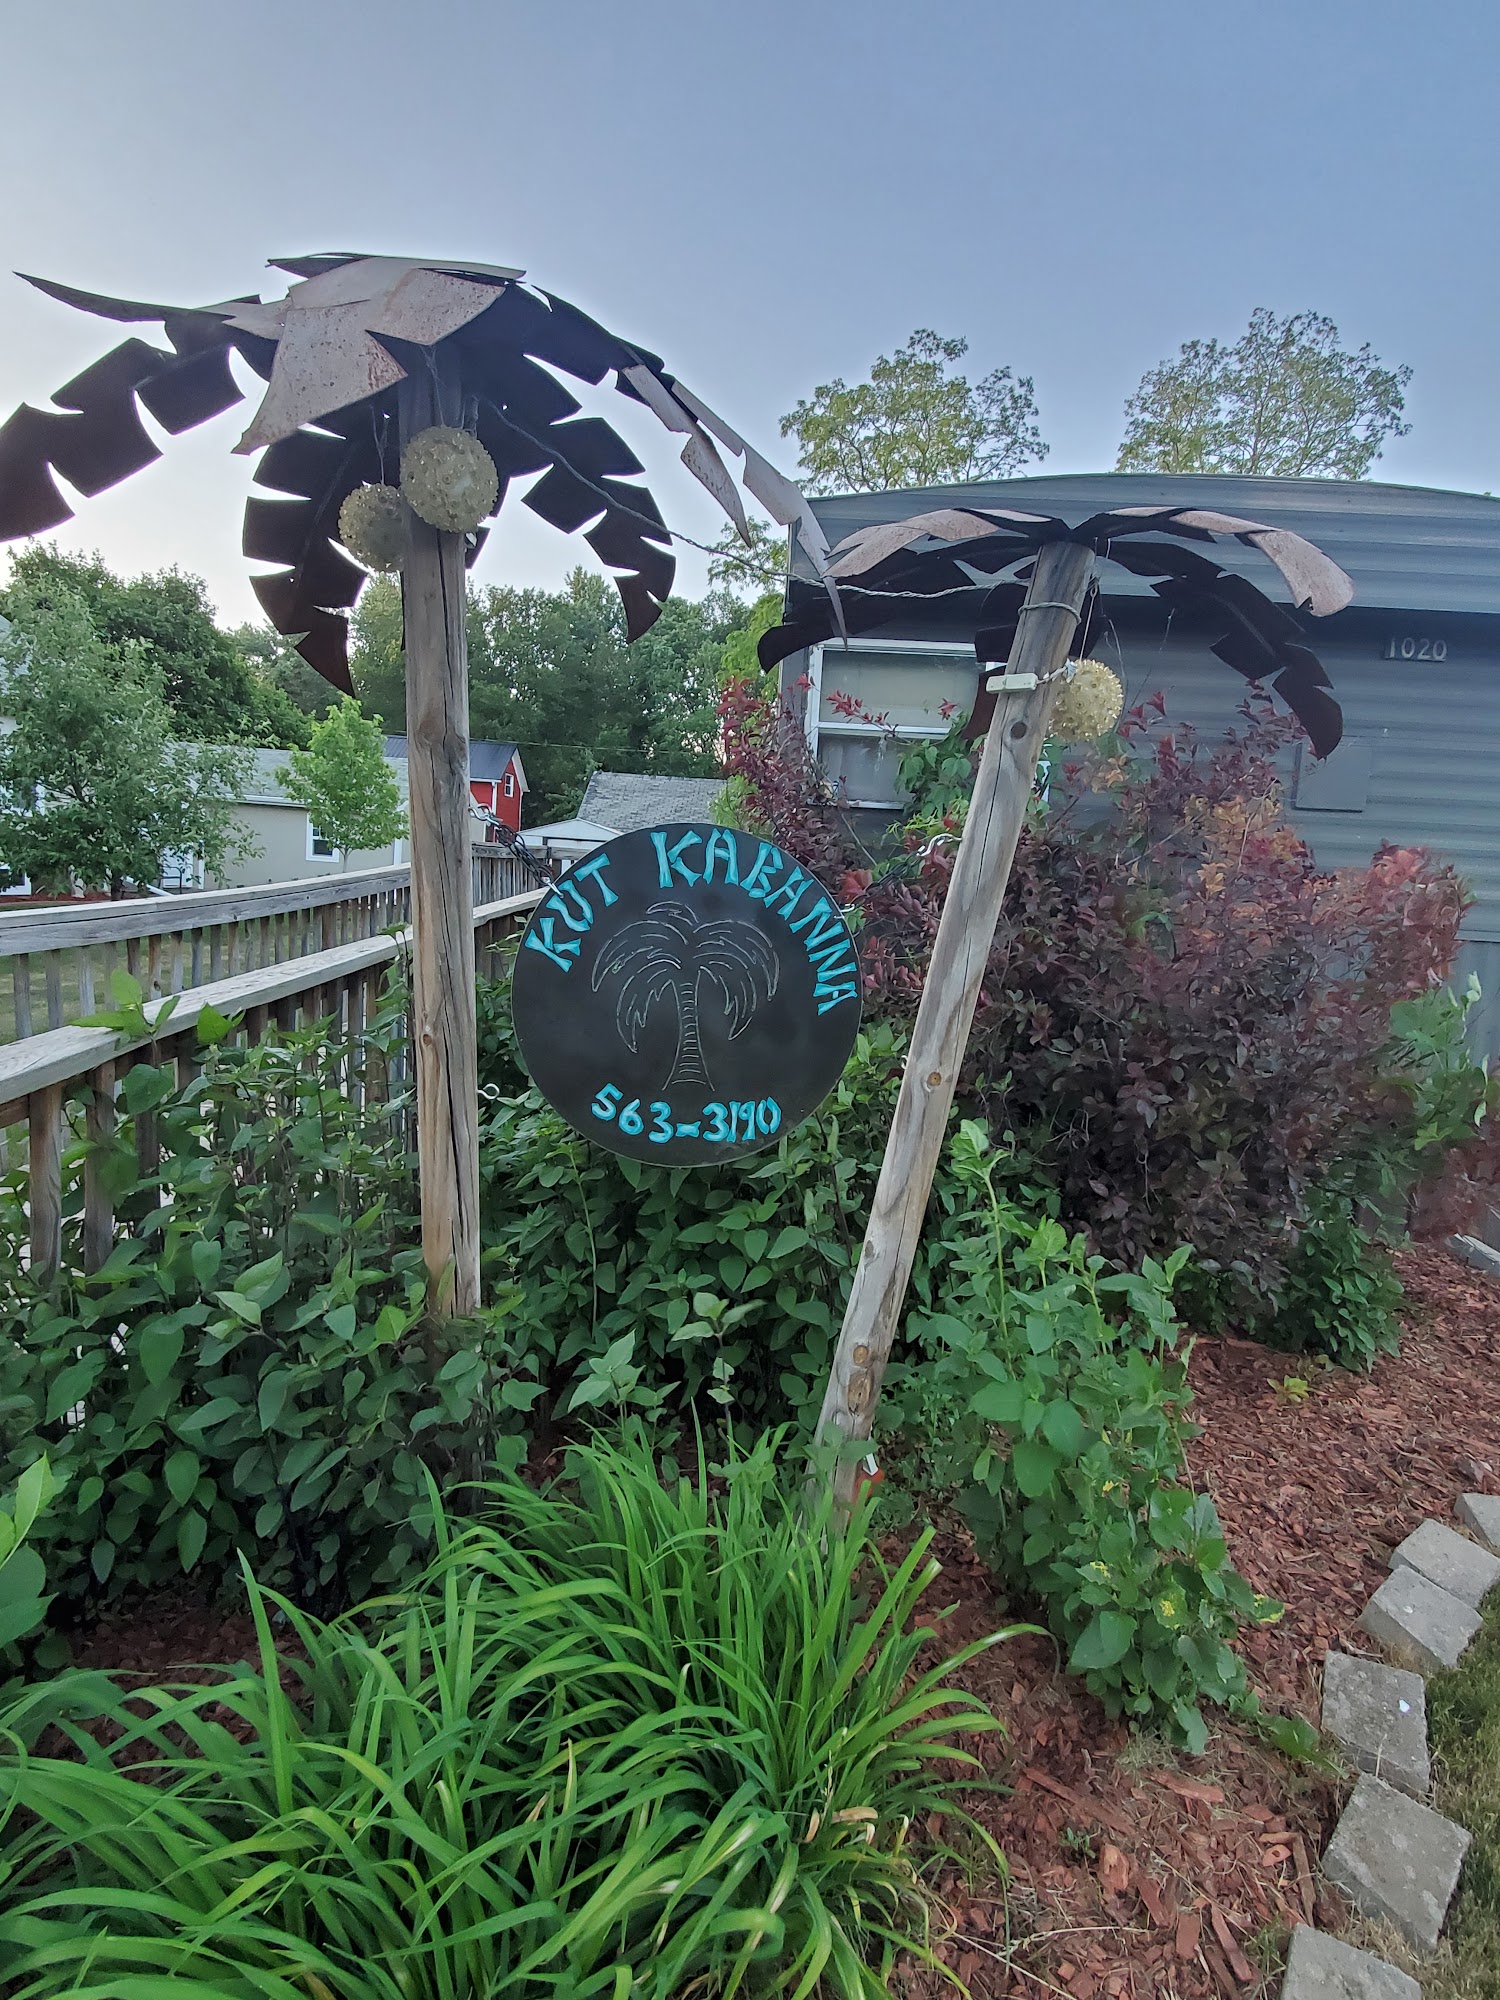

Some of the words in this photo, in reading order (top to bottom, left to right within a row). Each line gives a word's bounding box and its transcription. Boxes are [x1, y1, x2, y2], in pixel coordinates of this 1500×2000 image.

[1388, 637, 1447, 660] 1020
[525, 853, 619, 973] KUT
[650, 828, 858, 1016] KABANNA
[591, 1082, 782, 1144] 563-3190
